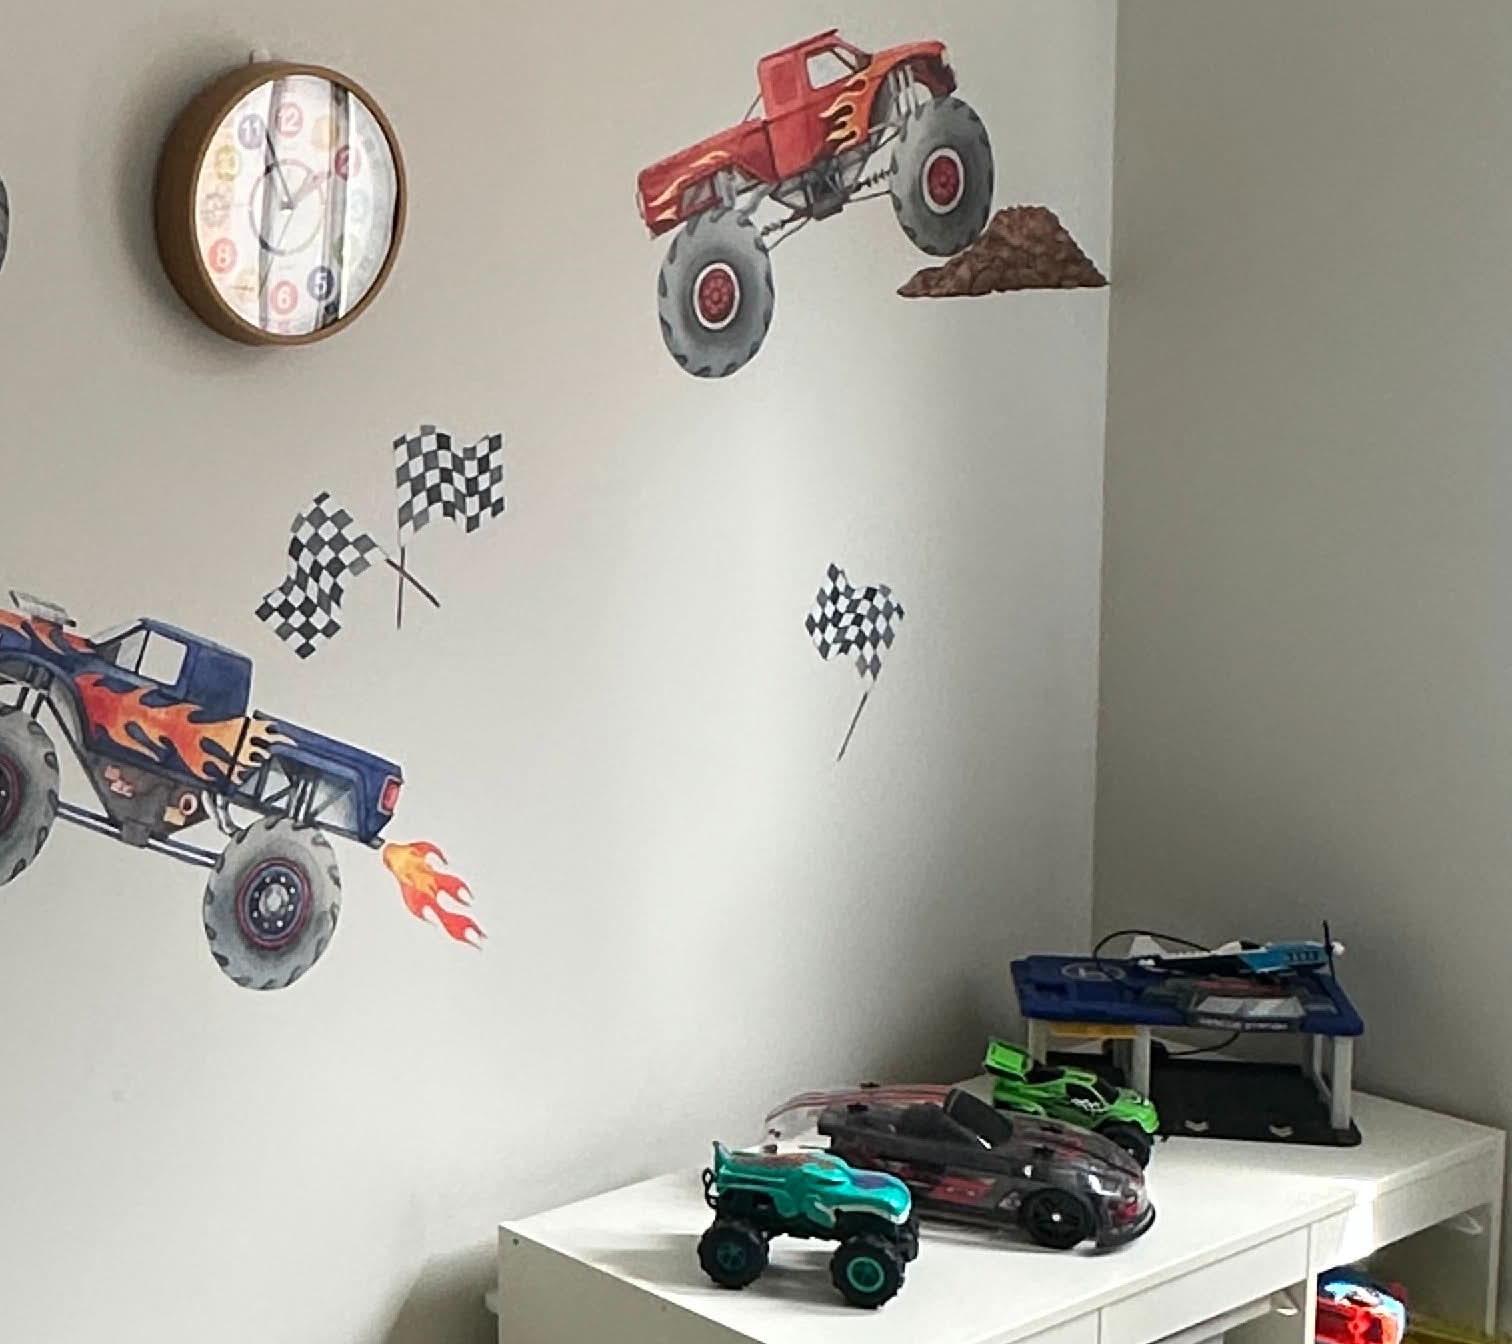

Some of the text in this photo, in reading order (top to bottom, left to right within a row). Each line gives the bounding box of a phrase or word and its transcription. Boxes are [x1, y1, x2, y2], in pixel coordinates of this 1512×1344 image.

[241, 119, 262, 143] 11
[216, 244, 231, 269] 8
[277, 285, 291, 309] 6
